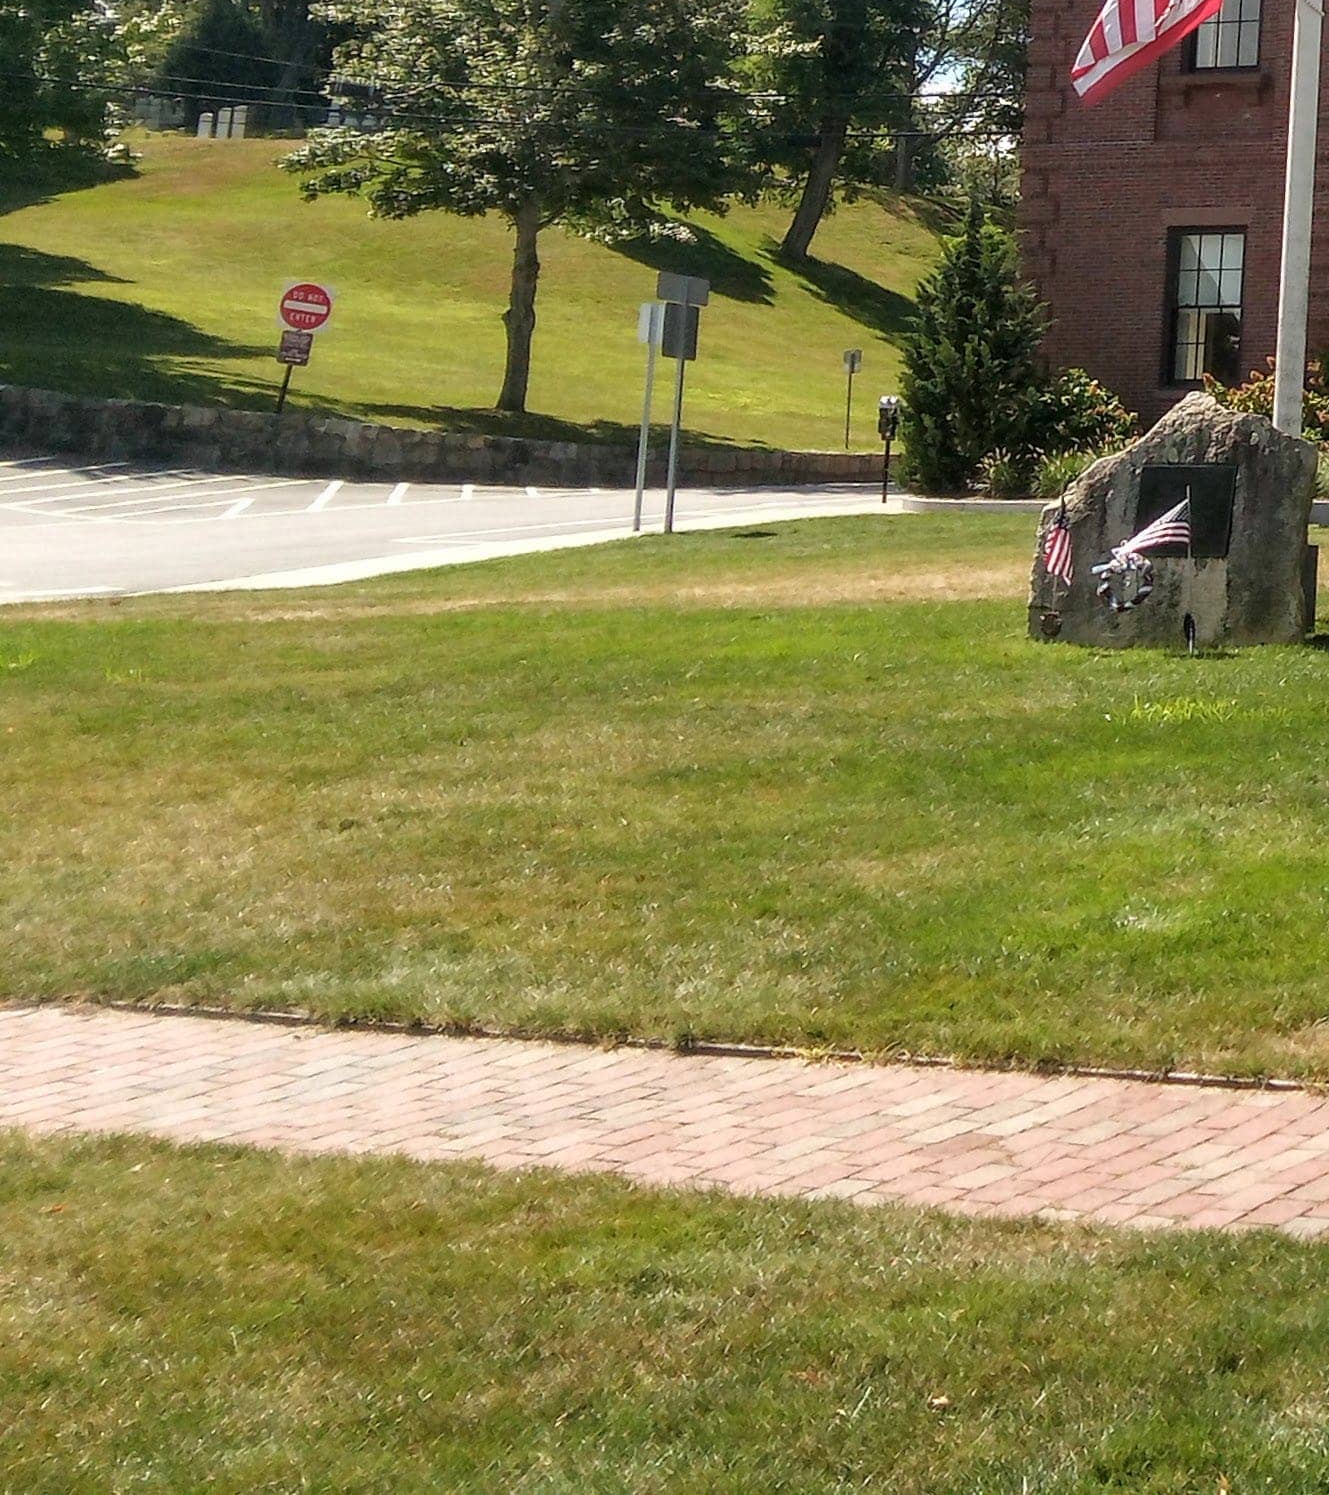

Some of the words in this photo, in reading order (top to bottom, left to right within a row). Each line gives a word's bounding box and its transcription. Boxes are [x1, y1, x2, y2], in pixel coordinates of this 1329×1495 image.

[292, 290, 304, 301] DO
[307, 293, 324, 303] NOT
[290, 312, 316, 324] ENTER
